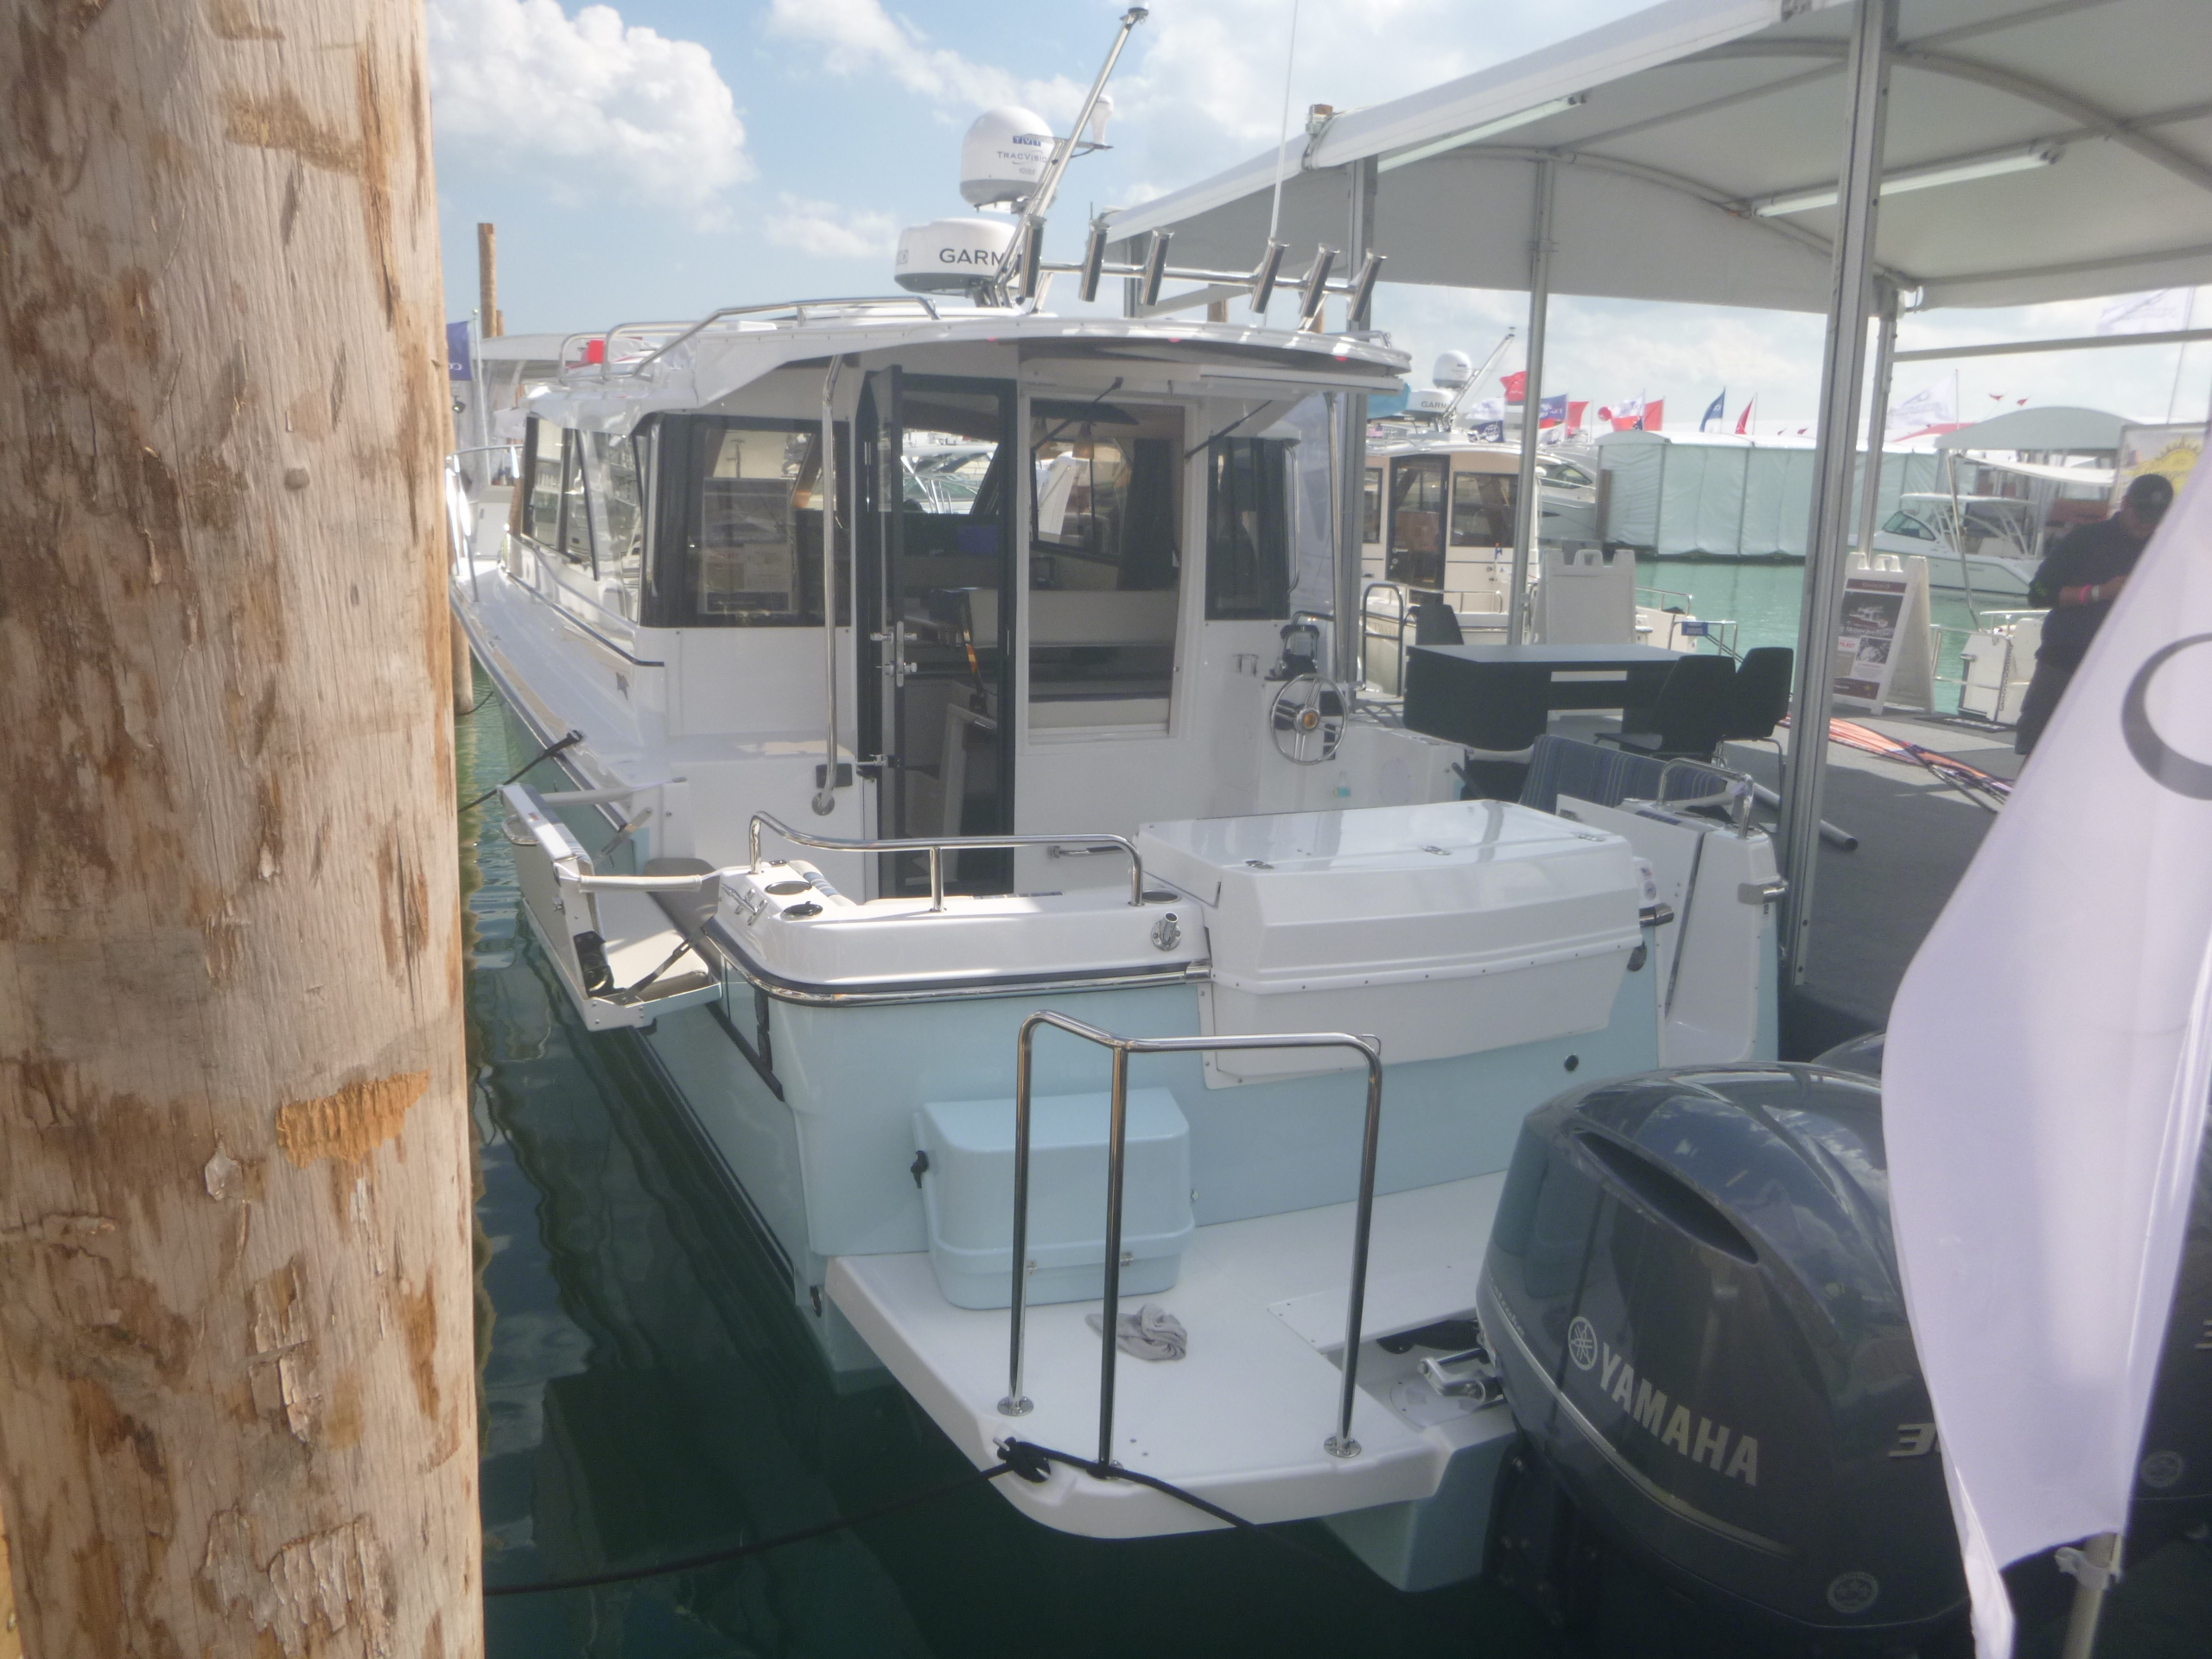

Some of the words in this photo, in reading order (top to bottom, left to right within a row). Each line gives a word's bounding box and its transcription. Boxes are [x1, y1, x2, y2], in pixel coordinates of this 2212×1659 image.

[996, 149, 1048, 163] TRACVISIO
[938, 248, 1005, 266] GARM
[1601, 1342, 1759, 1486] YAMAHA
[1888, 1422, 1939, 1457] 3
